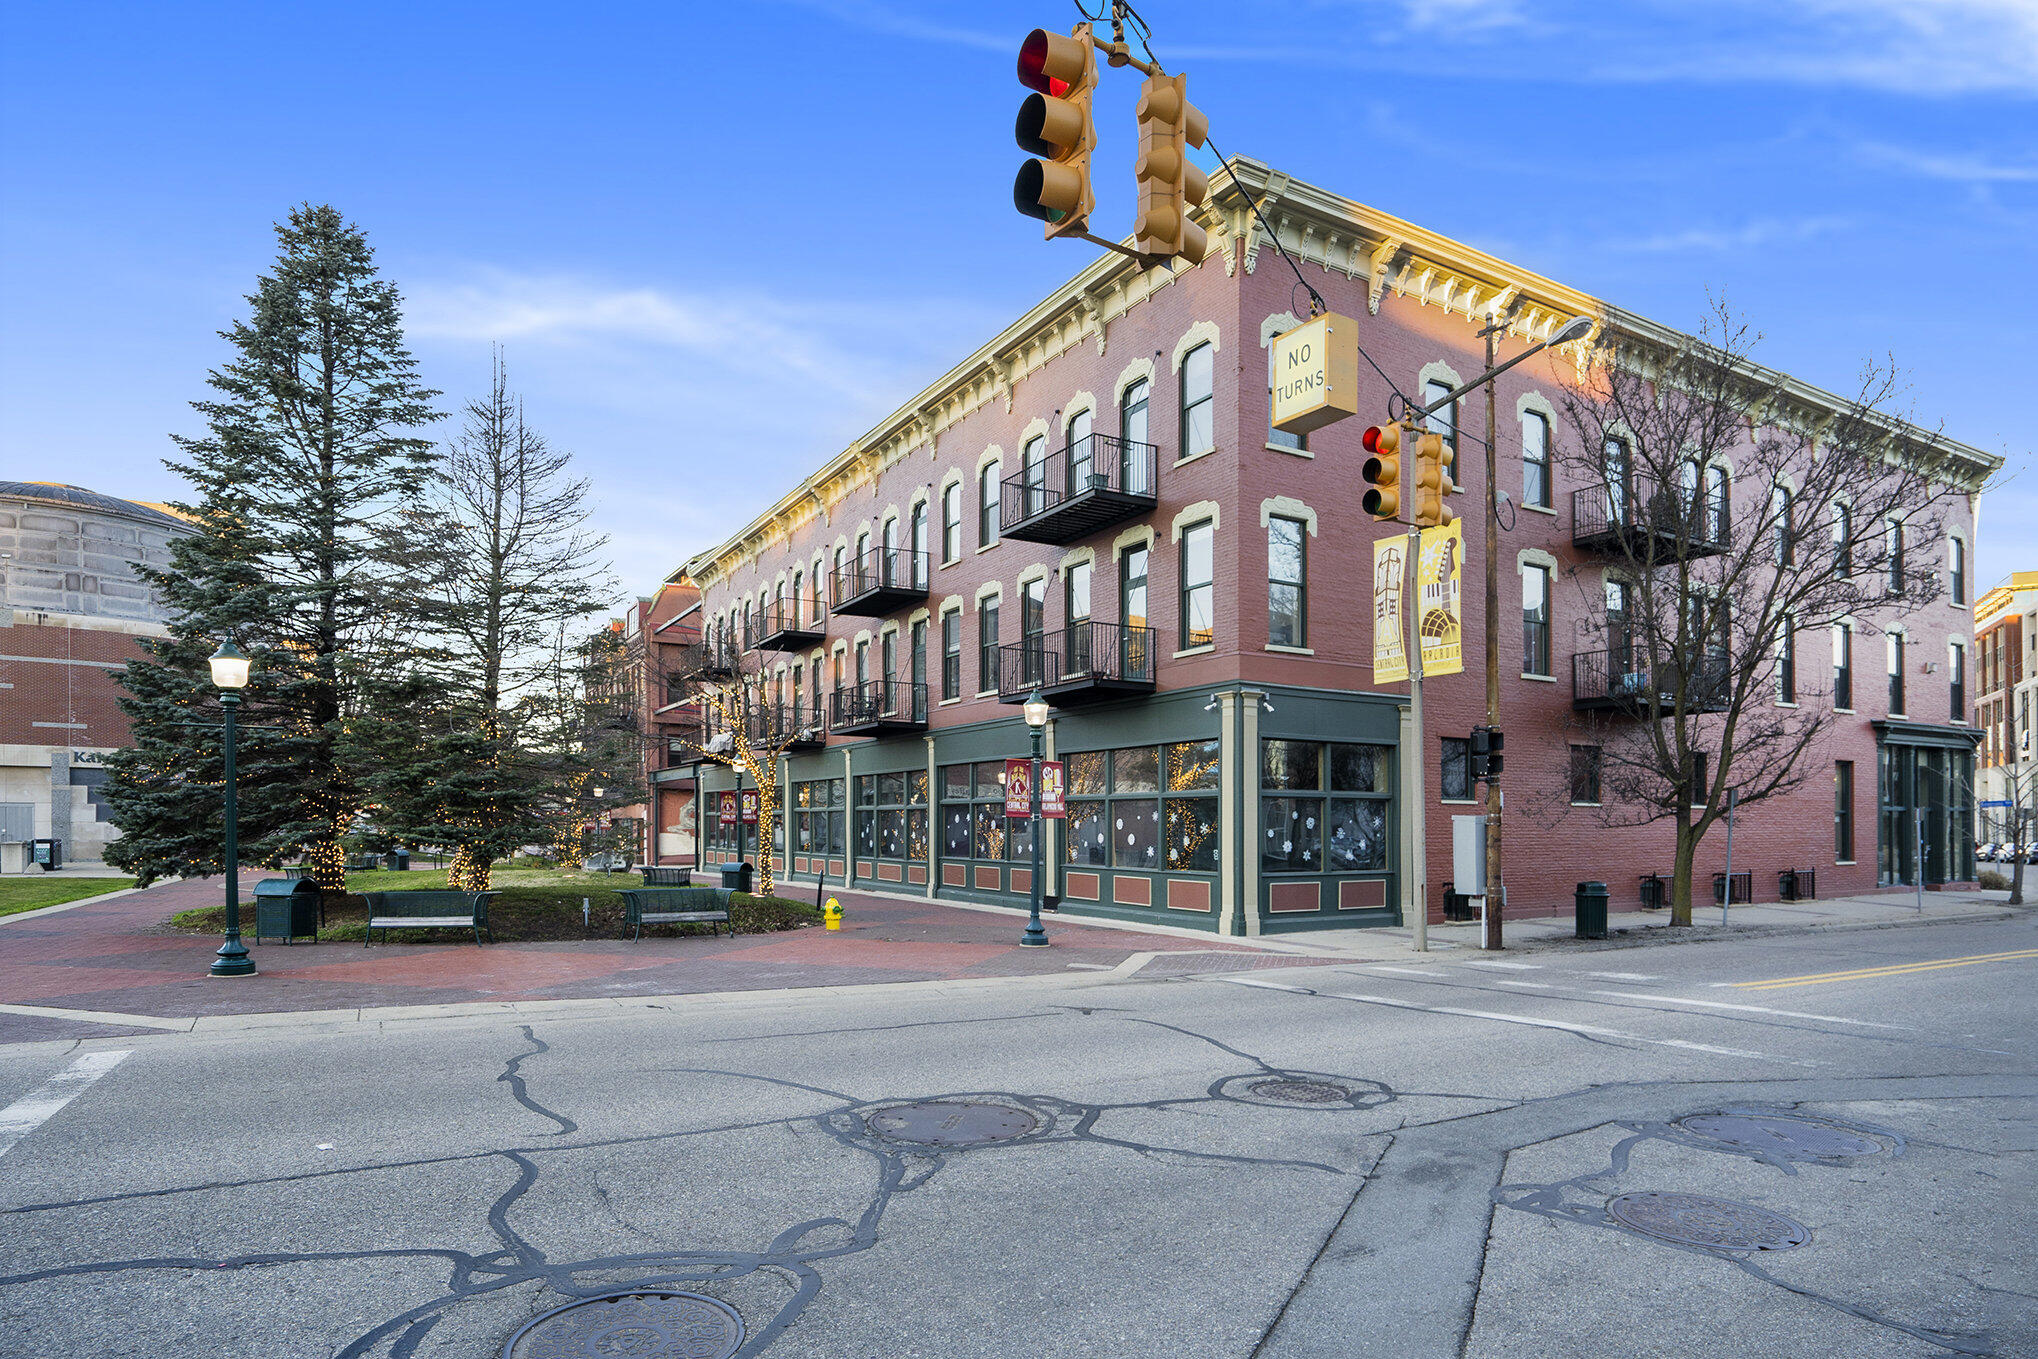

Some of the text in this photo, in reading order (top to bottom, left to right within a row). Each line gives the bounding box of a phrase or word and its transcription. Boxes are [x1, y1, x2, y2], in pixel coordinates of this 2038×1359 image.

[1289, 344, 1311, 369] NO
[1277, 370, 1324, 402] TURNS
[1015, 781, 1022, 794] K
